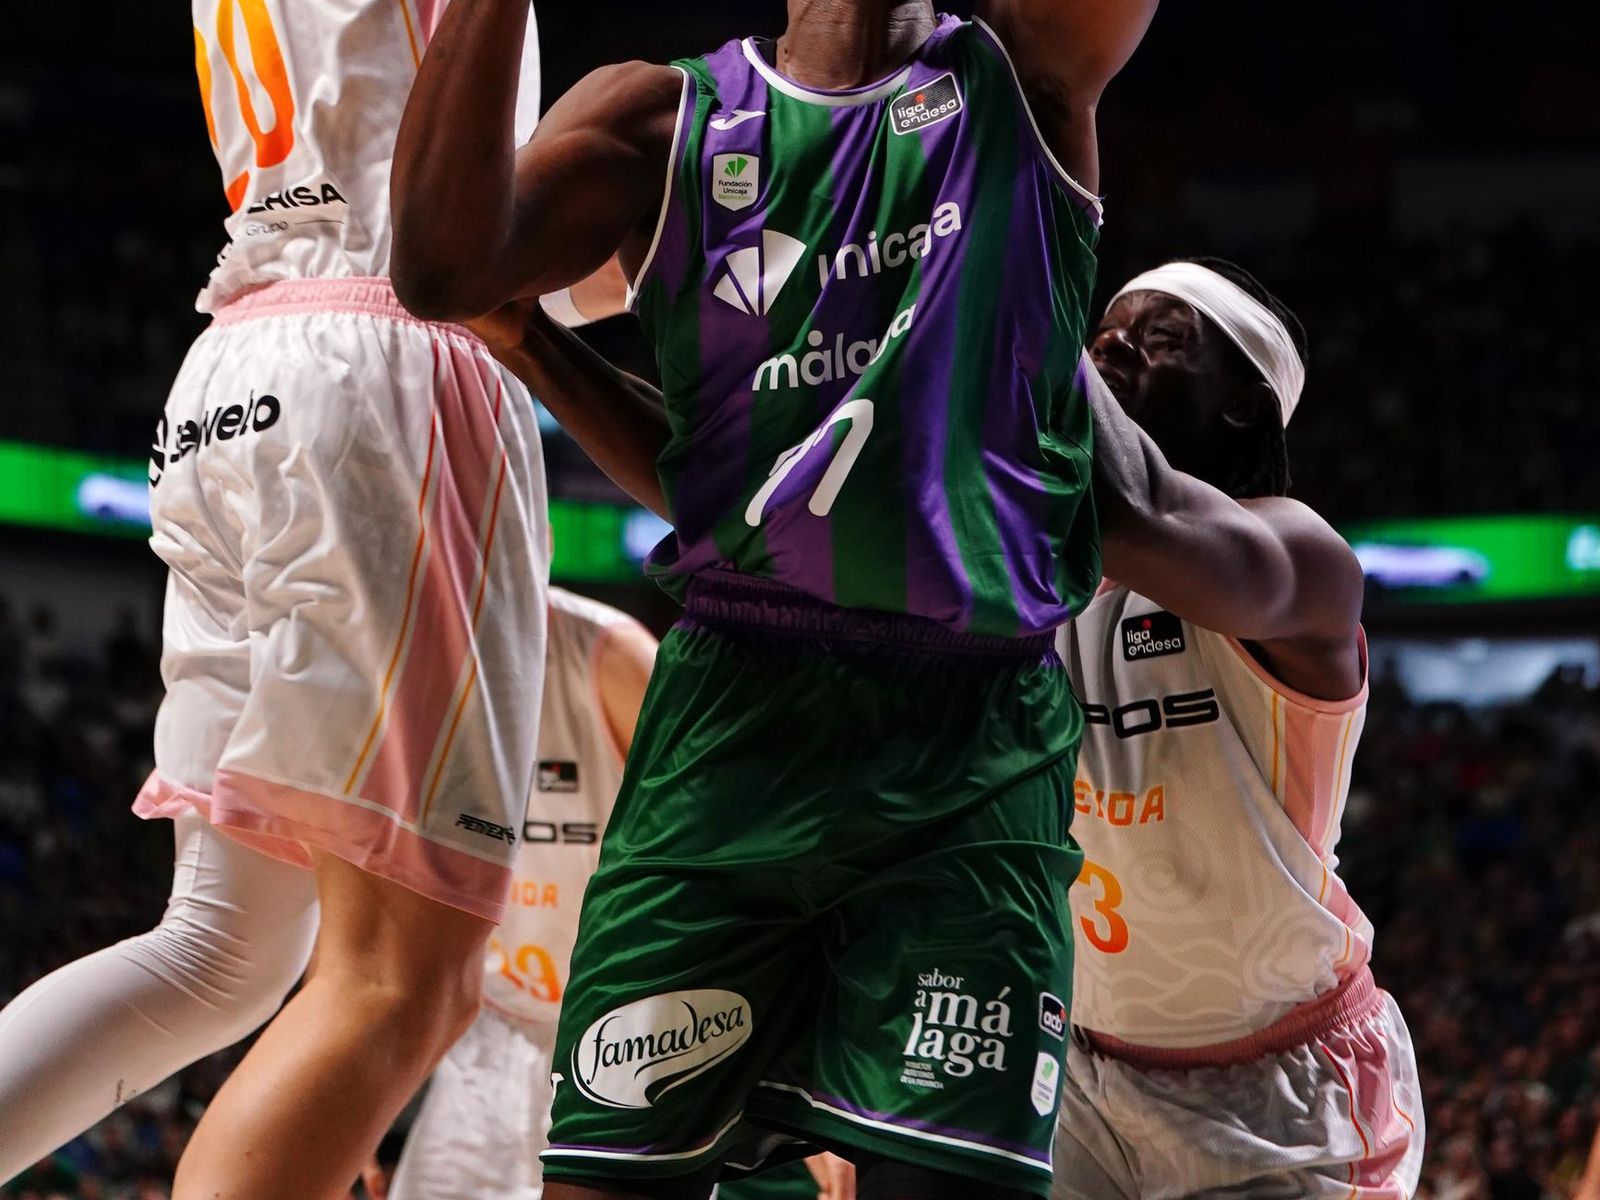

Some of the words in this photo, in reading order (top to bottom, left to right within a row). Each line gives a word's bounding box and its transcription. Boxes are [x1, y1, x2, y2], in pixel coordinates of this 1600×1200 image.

[897, 103, 925, 118] liga
[900, 99, 957, 128] endesa
[718, 180, 753, 188] Fundación
[723, 188, 748, 196] Unicaja
[1126, 630, 1151, 644] liga
[1128, 637, 1182, 656] endesa
[917, 968, 964, 990] sabor
[914, 990, 927, 1008] a
[1043, 1011, 1063, 1033] acb
[586, 1000, 745, 1085] famadesa
